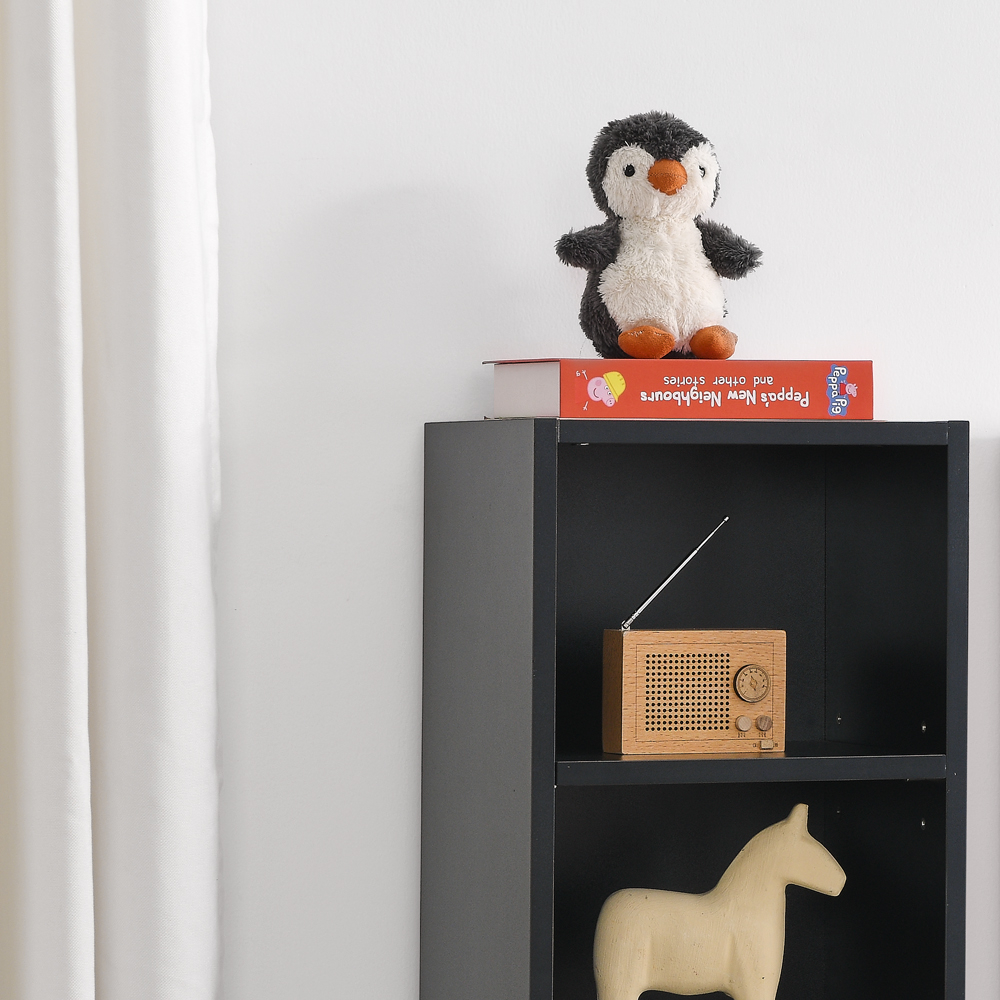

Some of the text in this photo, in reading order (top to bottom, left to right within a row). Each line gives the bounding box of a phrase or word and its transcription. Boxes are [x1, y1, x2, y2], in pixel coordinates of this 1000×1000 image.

[663, 375, 774, 388] and other stories
[828, 366, 848, 414] Peppa Pig
[640, 386, 810, 408] Peppa's New Neighbours
